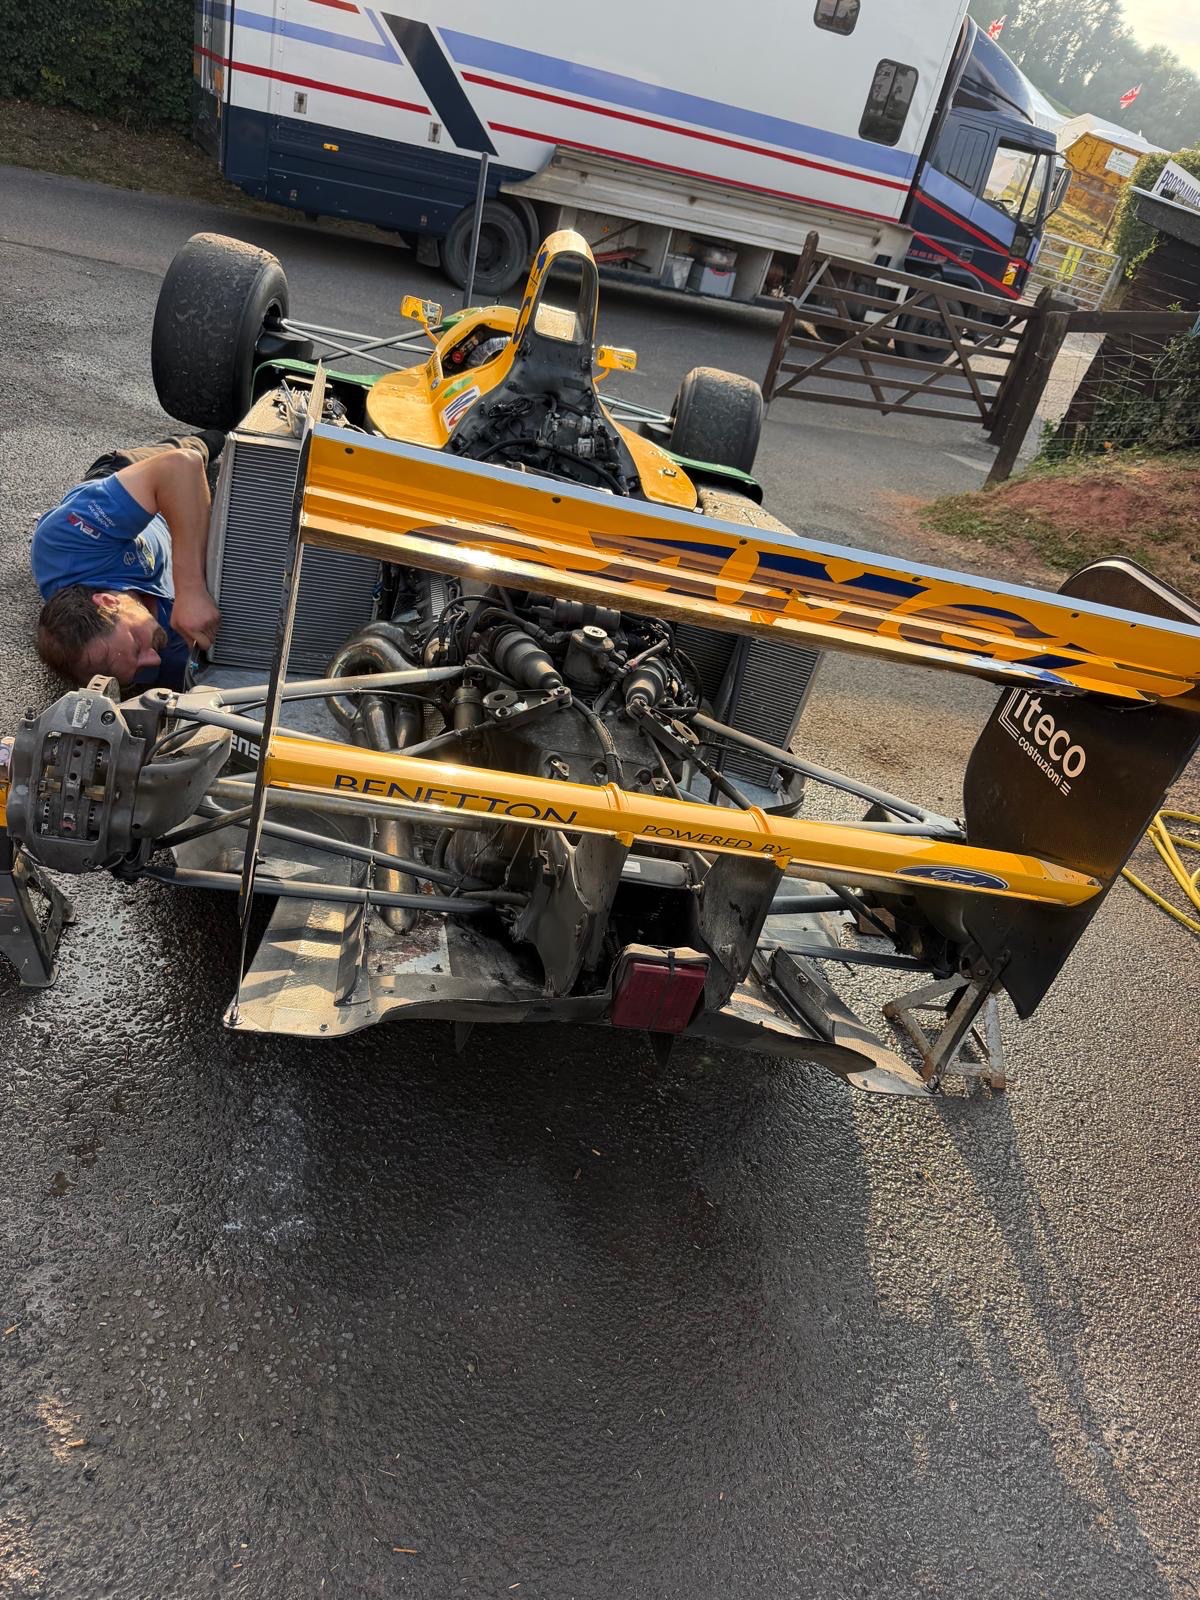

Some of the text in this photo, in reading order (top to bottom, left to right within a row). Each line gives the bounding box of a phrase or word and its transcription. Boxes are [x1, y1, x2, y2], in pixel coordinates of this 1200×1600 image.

[1018, 736, 1064, 787] costruzioni
[333, 774, 578, 825] BENETTON
[641, 825, 792, 855] POWERED BY
